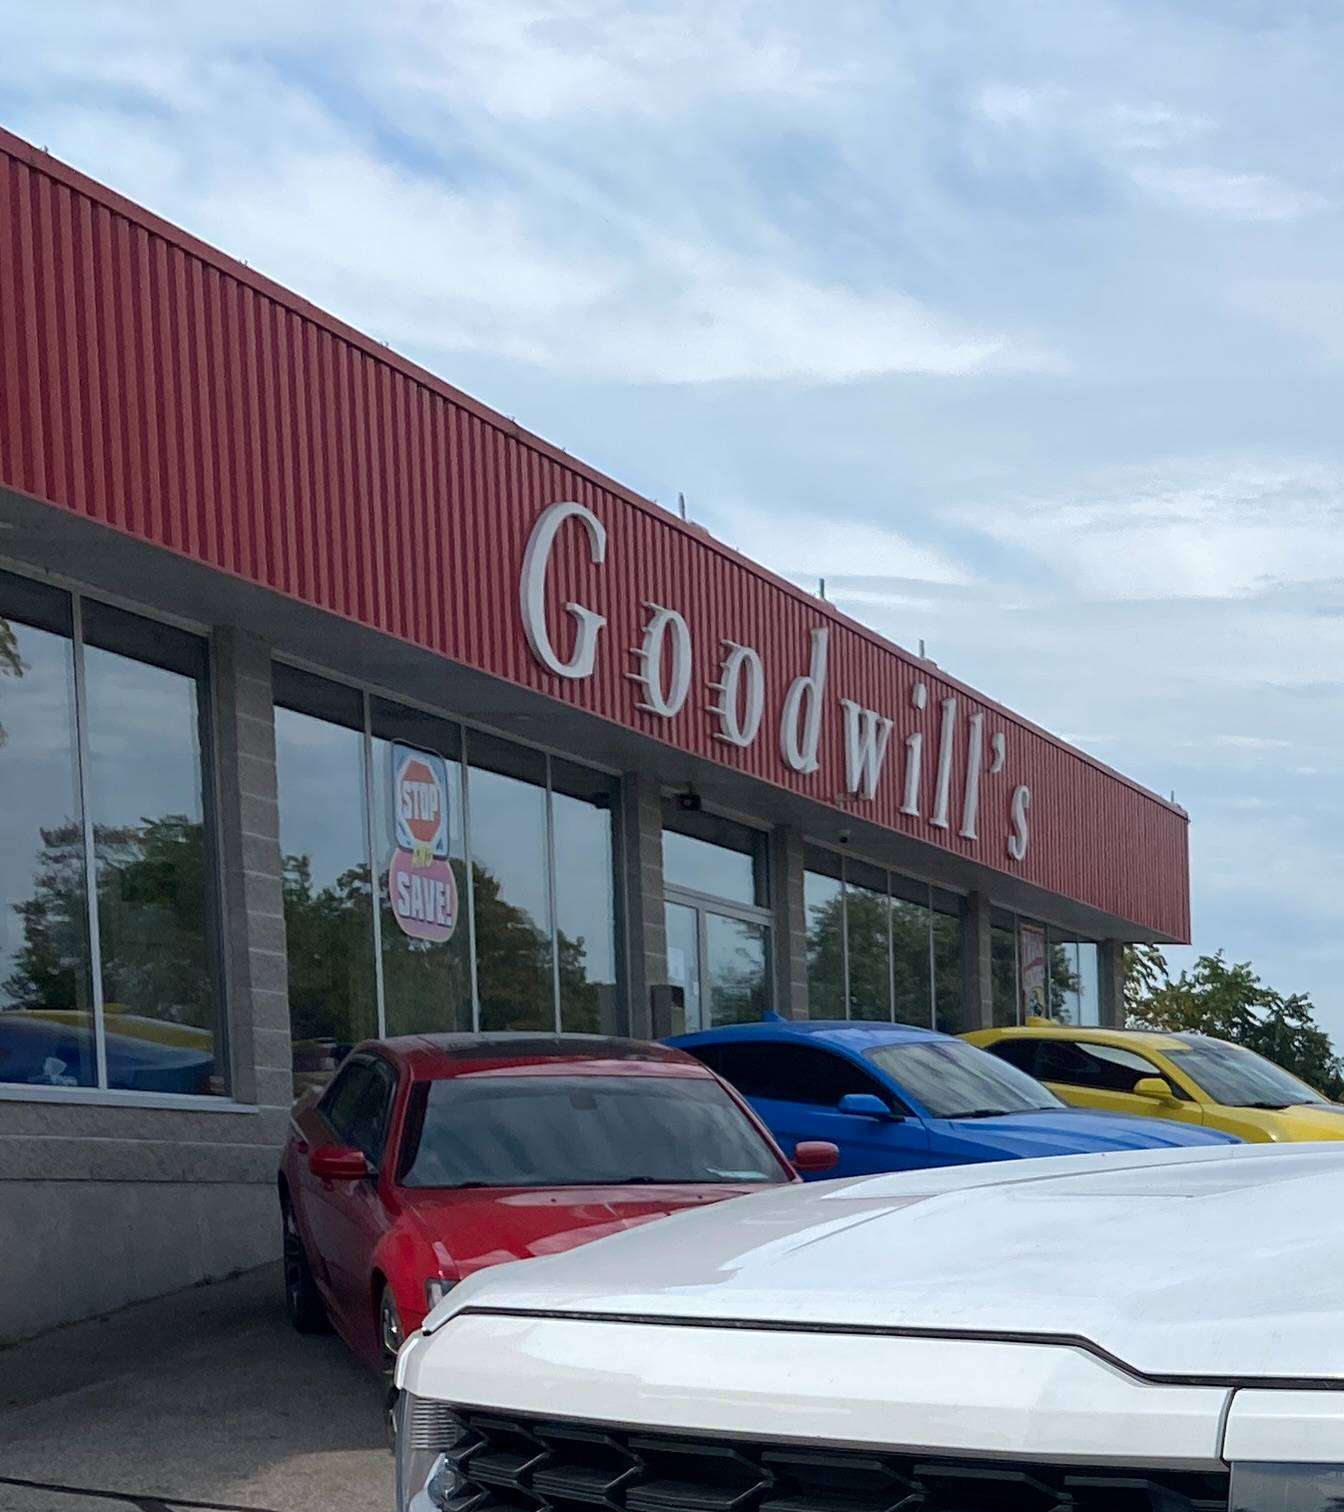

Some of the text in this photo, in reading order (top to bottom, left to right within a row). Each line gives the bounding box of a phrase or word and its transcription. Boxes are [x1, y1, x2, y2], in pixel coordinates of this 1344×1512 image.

[519, 501, 1031, 862] Goodwill's
[401, 781, 441, 822] STOP
[397, 870, 453, 927] SAVE!
